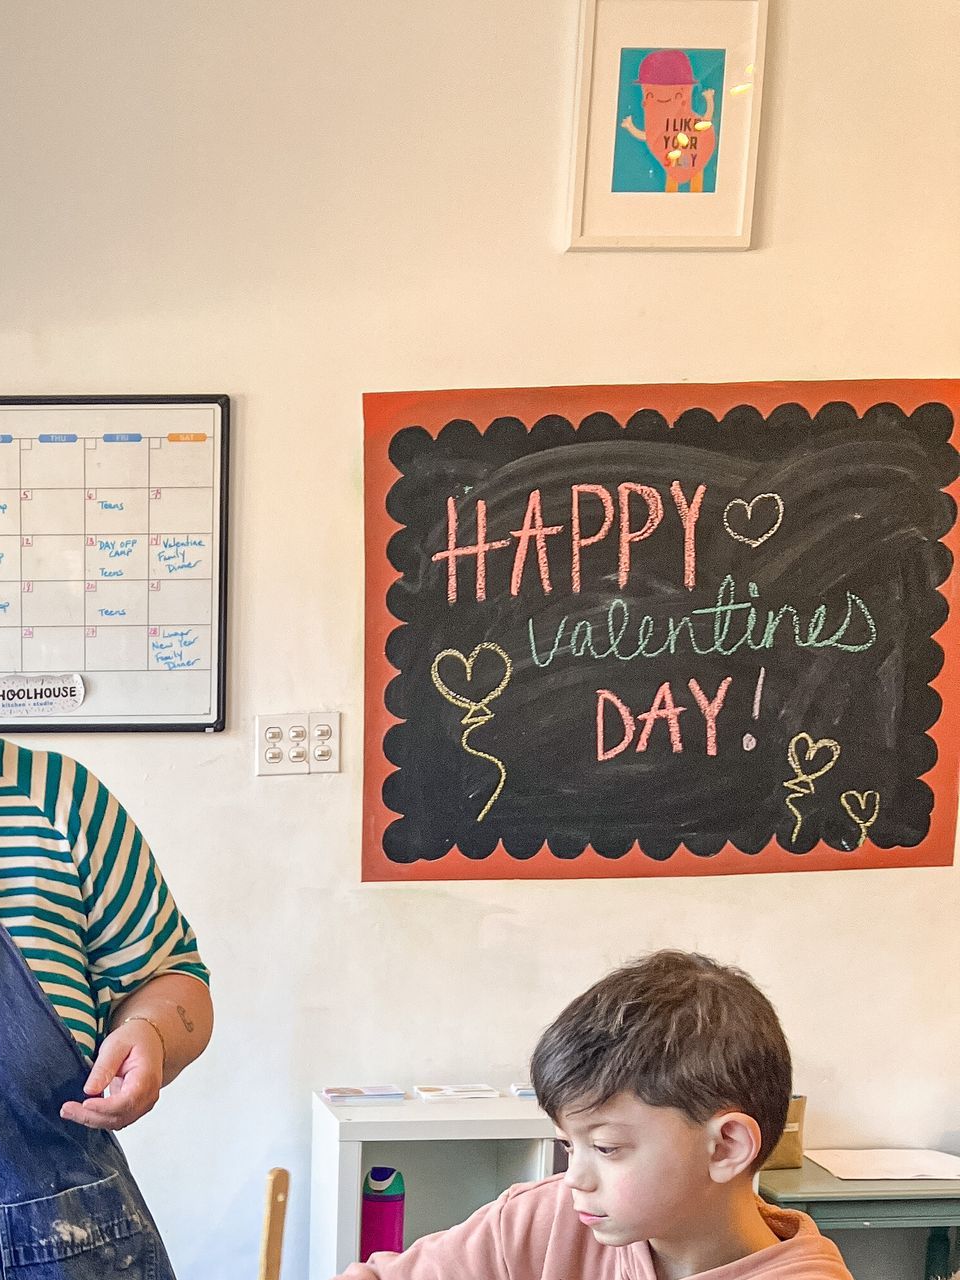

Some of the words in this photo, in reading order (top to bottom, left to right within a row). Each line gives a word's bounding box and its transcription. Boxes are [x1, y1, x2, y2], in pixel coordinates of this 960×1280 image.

[673, 118, 701, 131] LIK
[98, 540, 115, 550] DAY
[432, 481, 708, 603] HAPPY
[99, 567, 124, 577] Teens
[98, 608, 126, 616] Teens
[596, 667, 765, 761] DAY!
